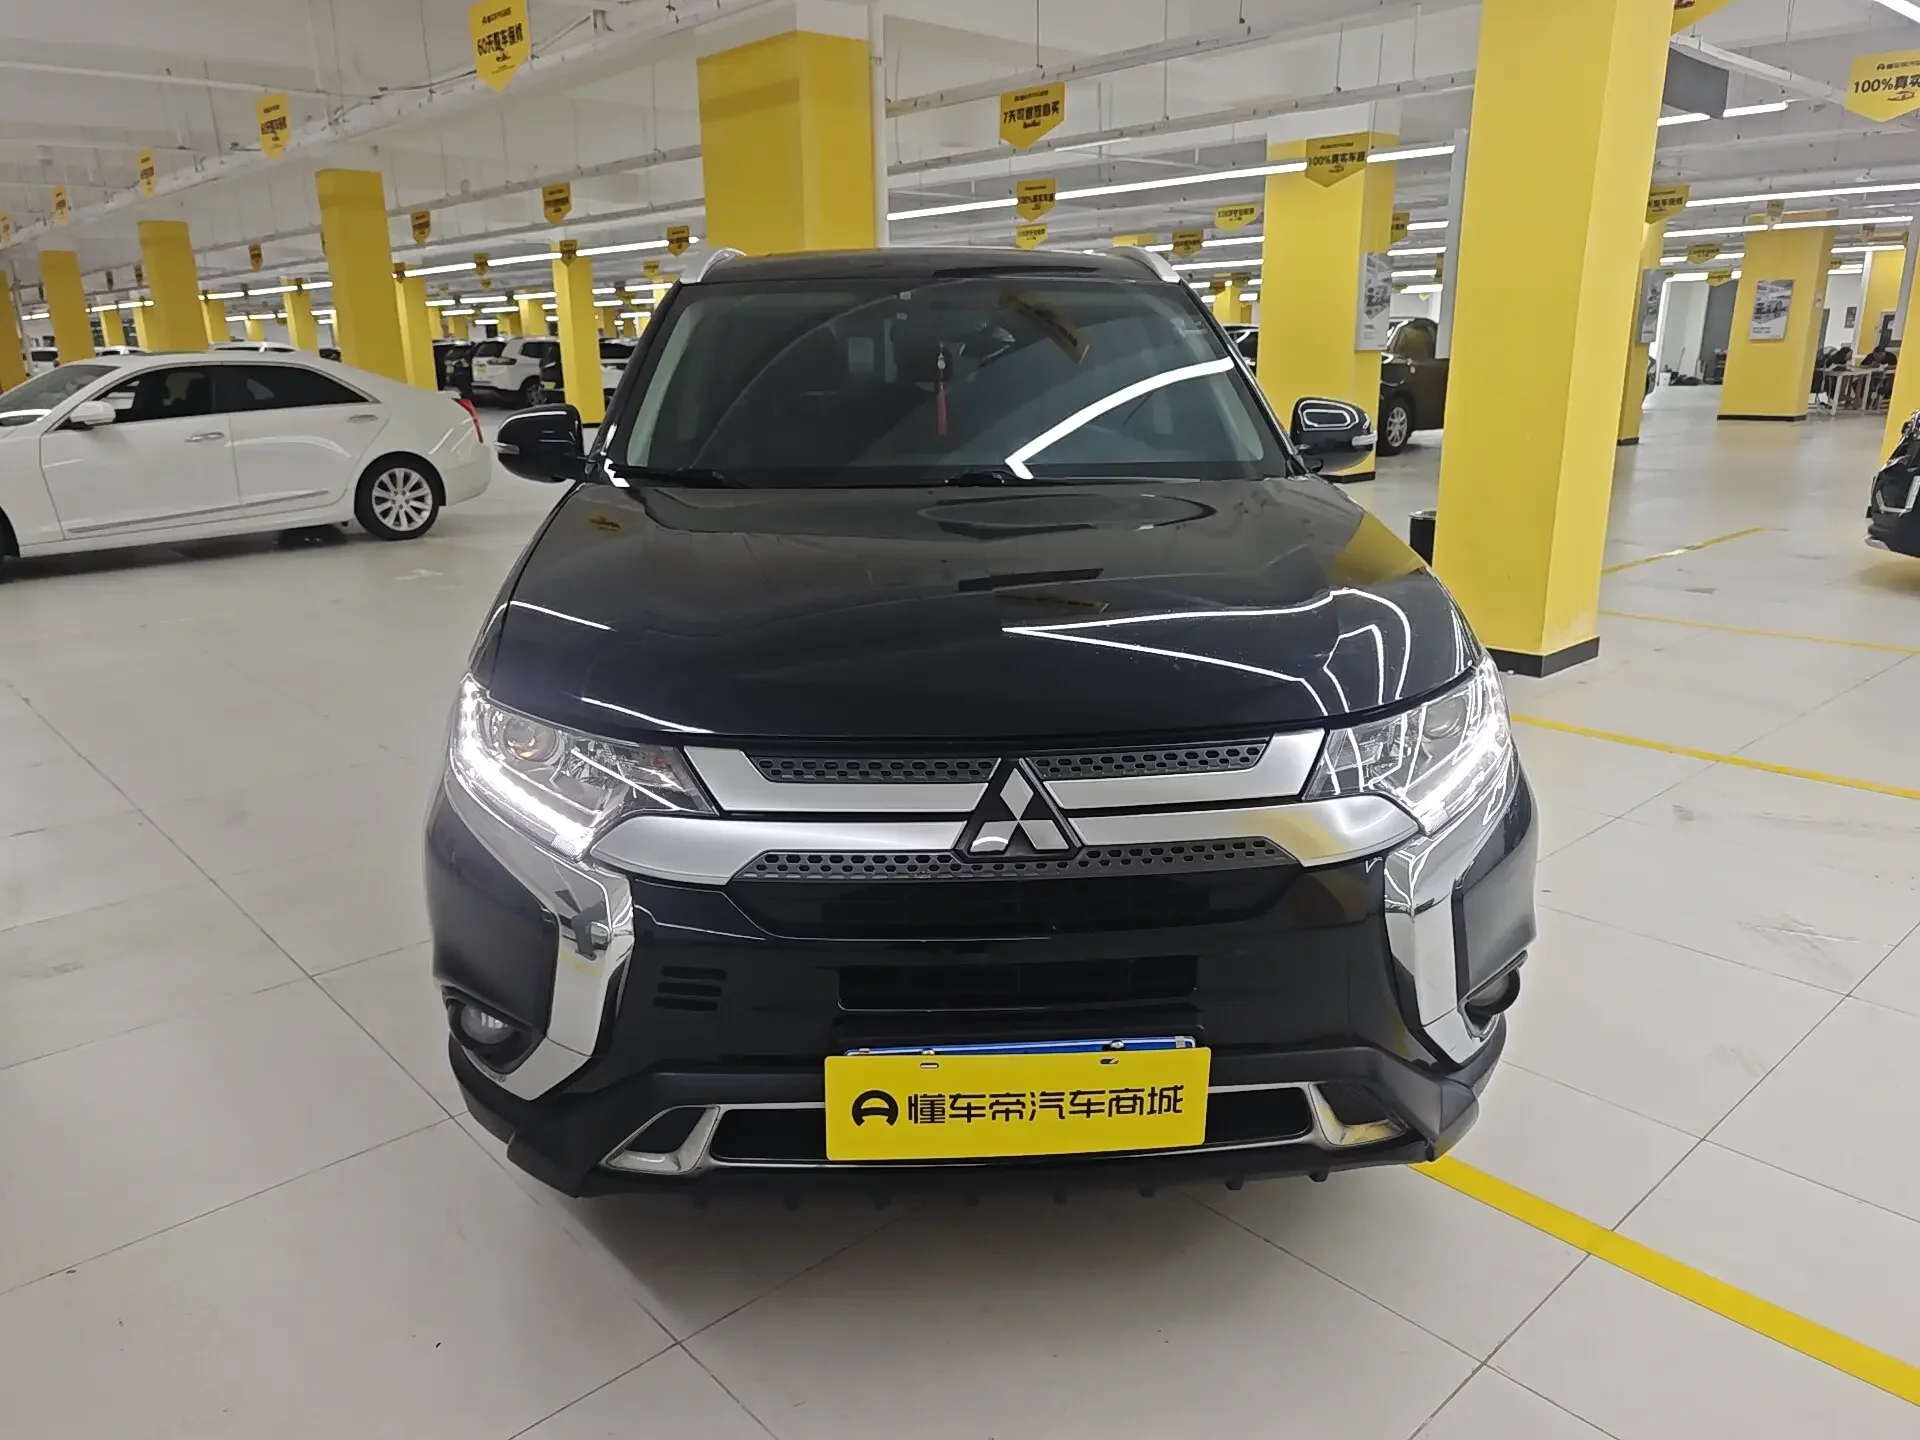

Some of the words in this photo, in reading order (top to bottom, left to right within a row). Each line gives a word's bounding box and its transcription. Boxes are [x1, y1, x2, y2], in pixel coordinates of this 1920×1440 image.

[907, 1084, 1185, 1125] 懂车帝汽车商城
